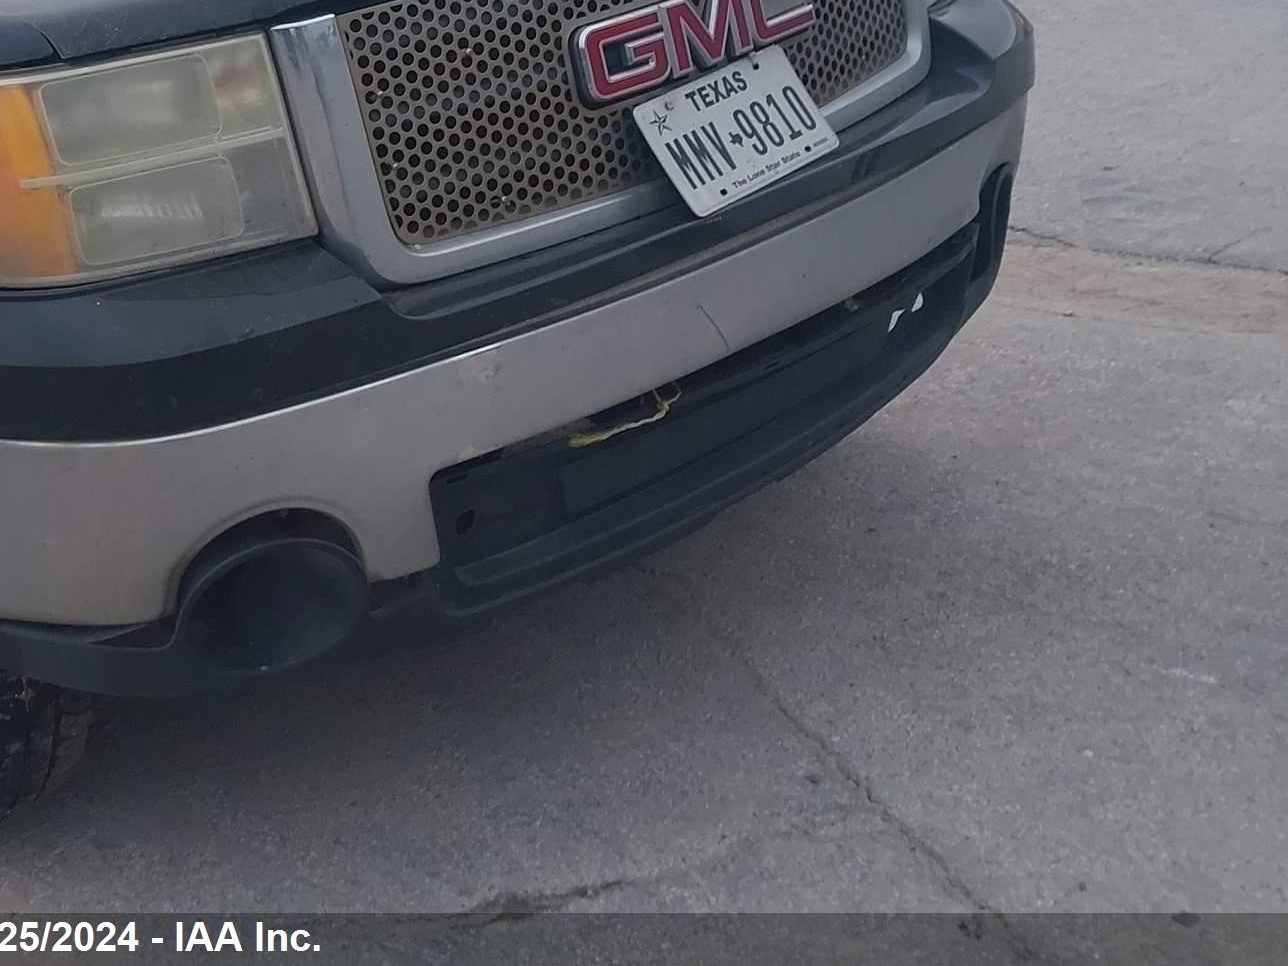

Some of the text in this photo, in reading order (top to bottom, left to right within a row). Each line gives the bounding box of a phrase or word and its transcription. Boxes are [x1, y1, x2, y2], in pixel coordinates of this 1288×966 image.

[684, 70, 748, 112] TEXAS
[731, 151, 801, 189] The Lone Star State
